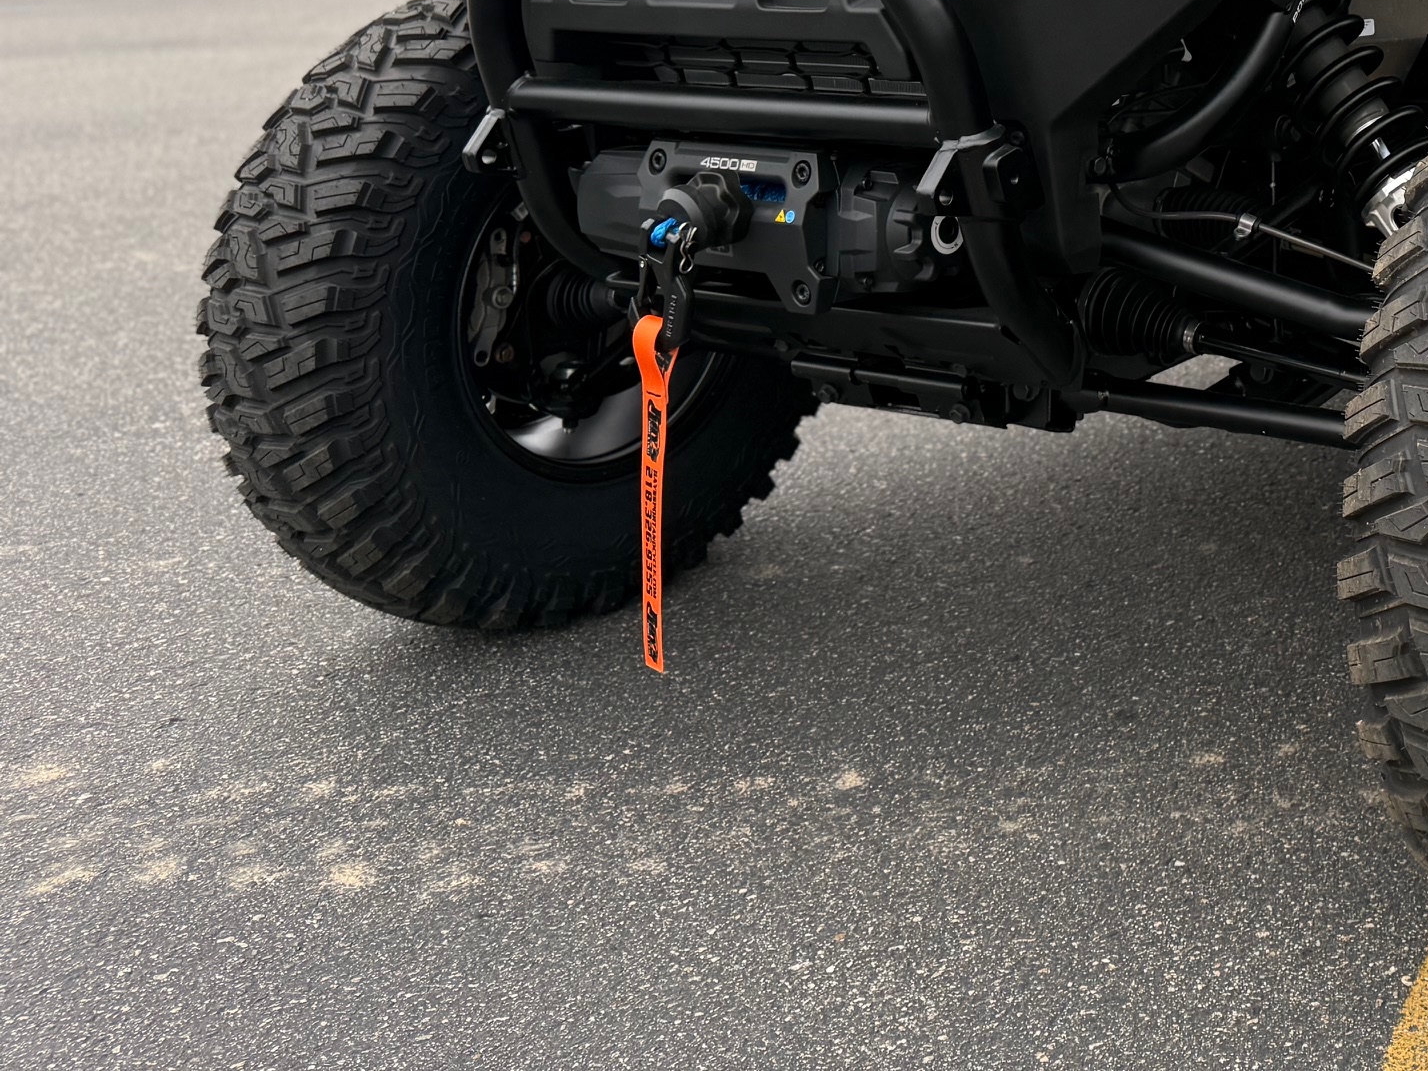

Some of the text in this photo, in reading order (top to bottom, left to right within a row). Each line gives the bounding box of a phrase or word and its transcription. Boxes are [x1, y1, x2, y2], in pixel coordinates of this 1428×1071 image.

[700, 157, 756, 171] 4500 HD
[645, 465, 653, 596] 218.326.9355
